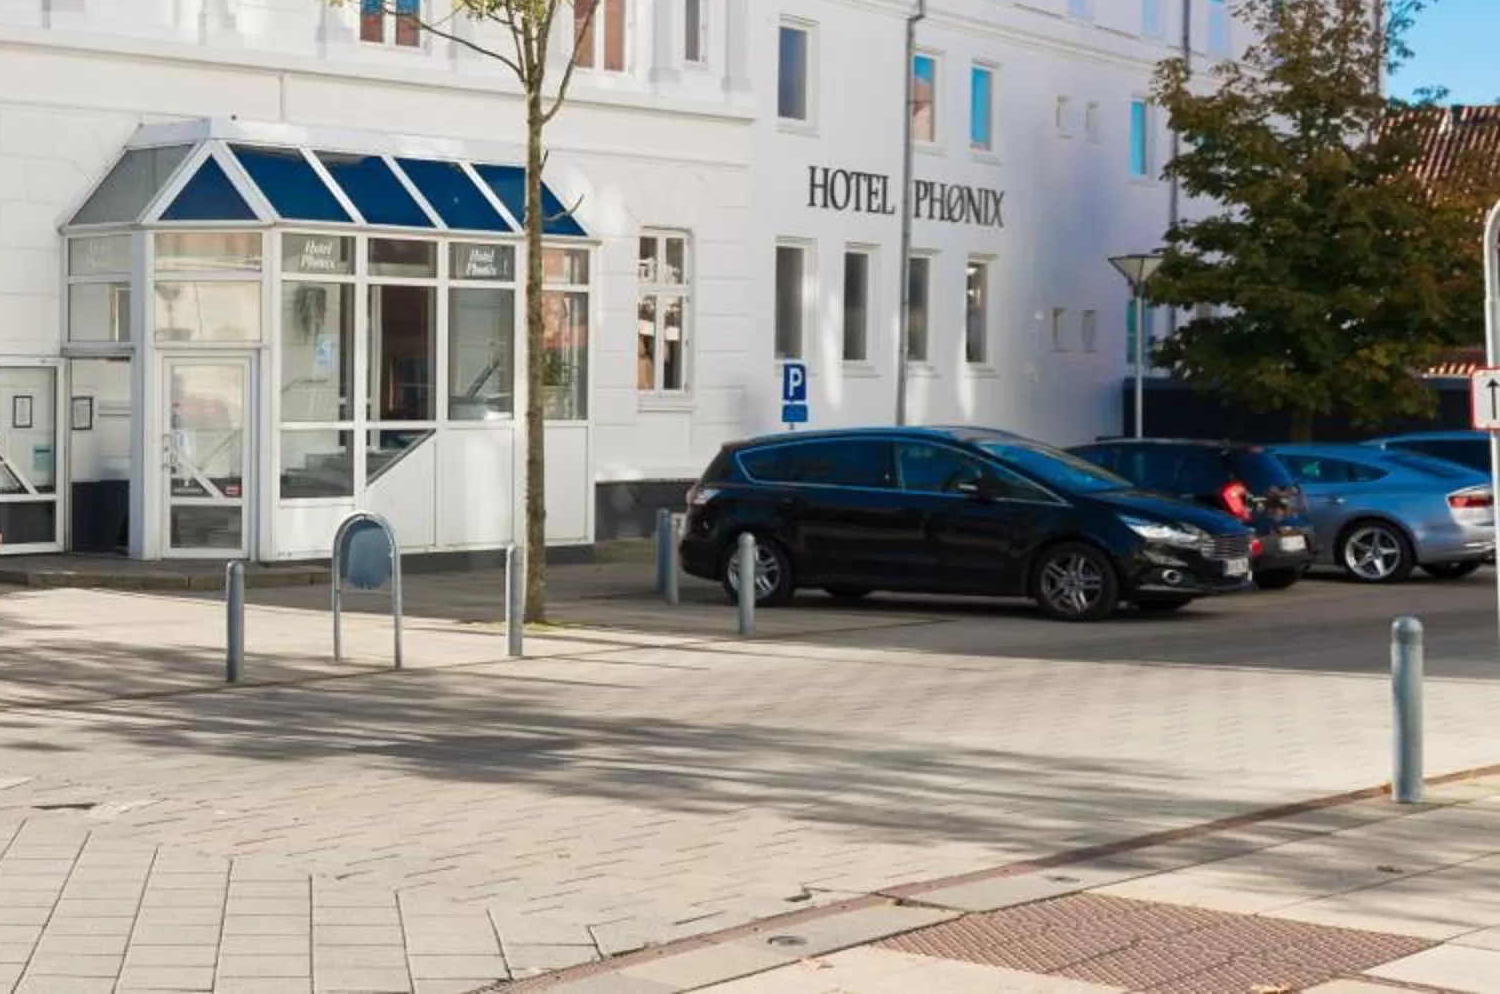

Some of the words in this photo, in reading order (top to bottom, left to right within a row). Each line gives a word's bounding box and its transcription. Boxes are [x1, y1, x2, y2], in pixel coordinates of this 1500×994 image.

[807, 165, 895, 215] HOTEL
[913, 179, 1005, 228] PHØNIX
[789, 367, 803, 398] P
